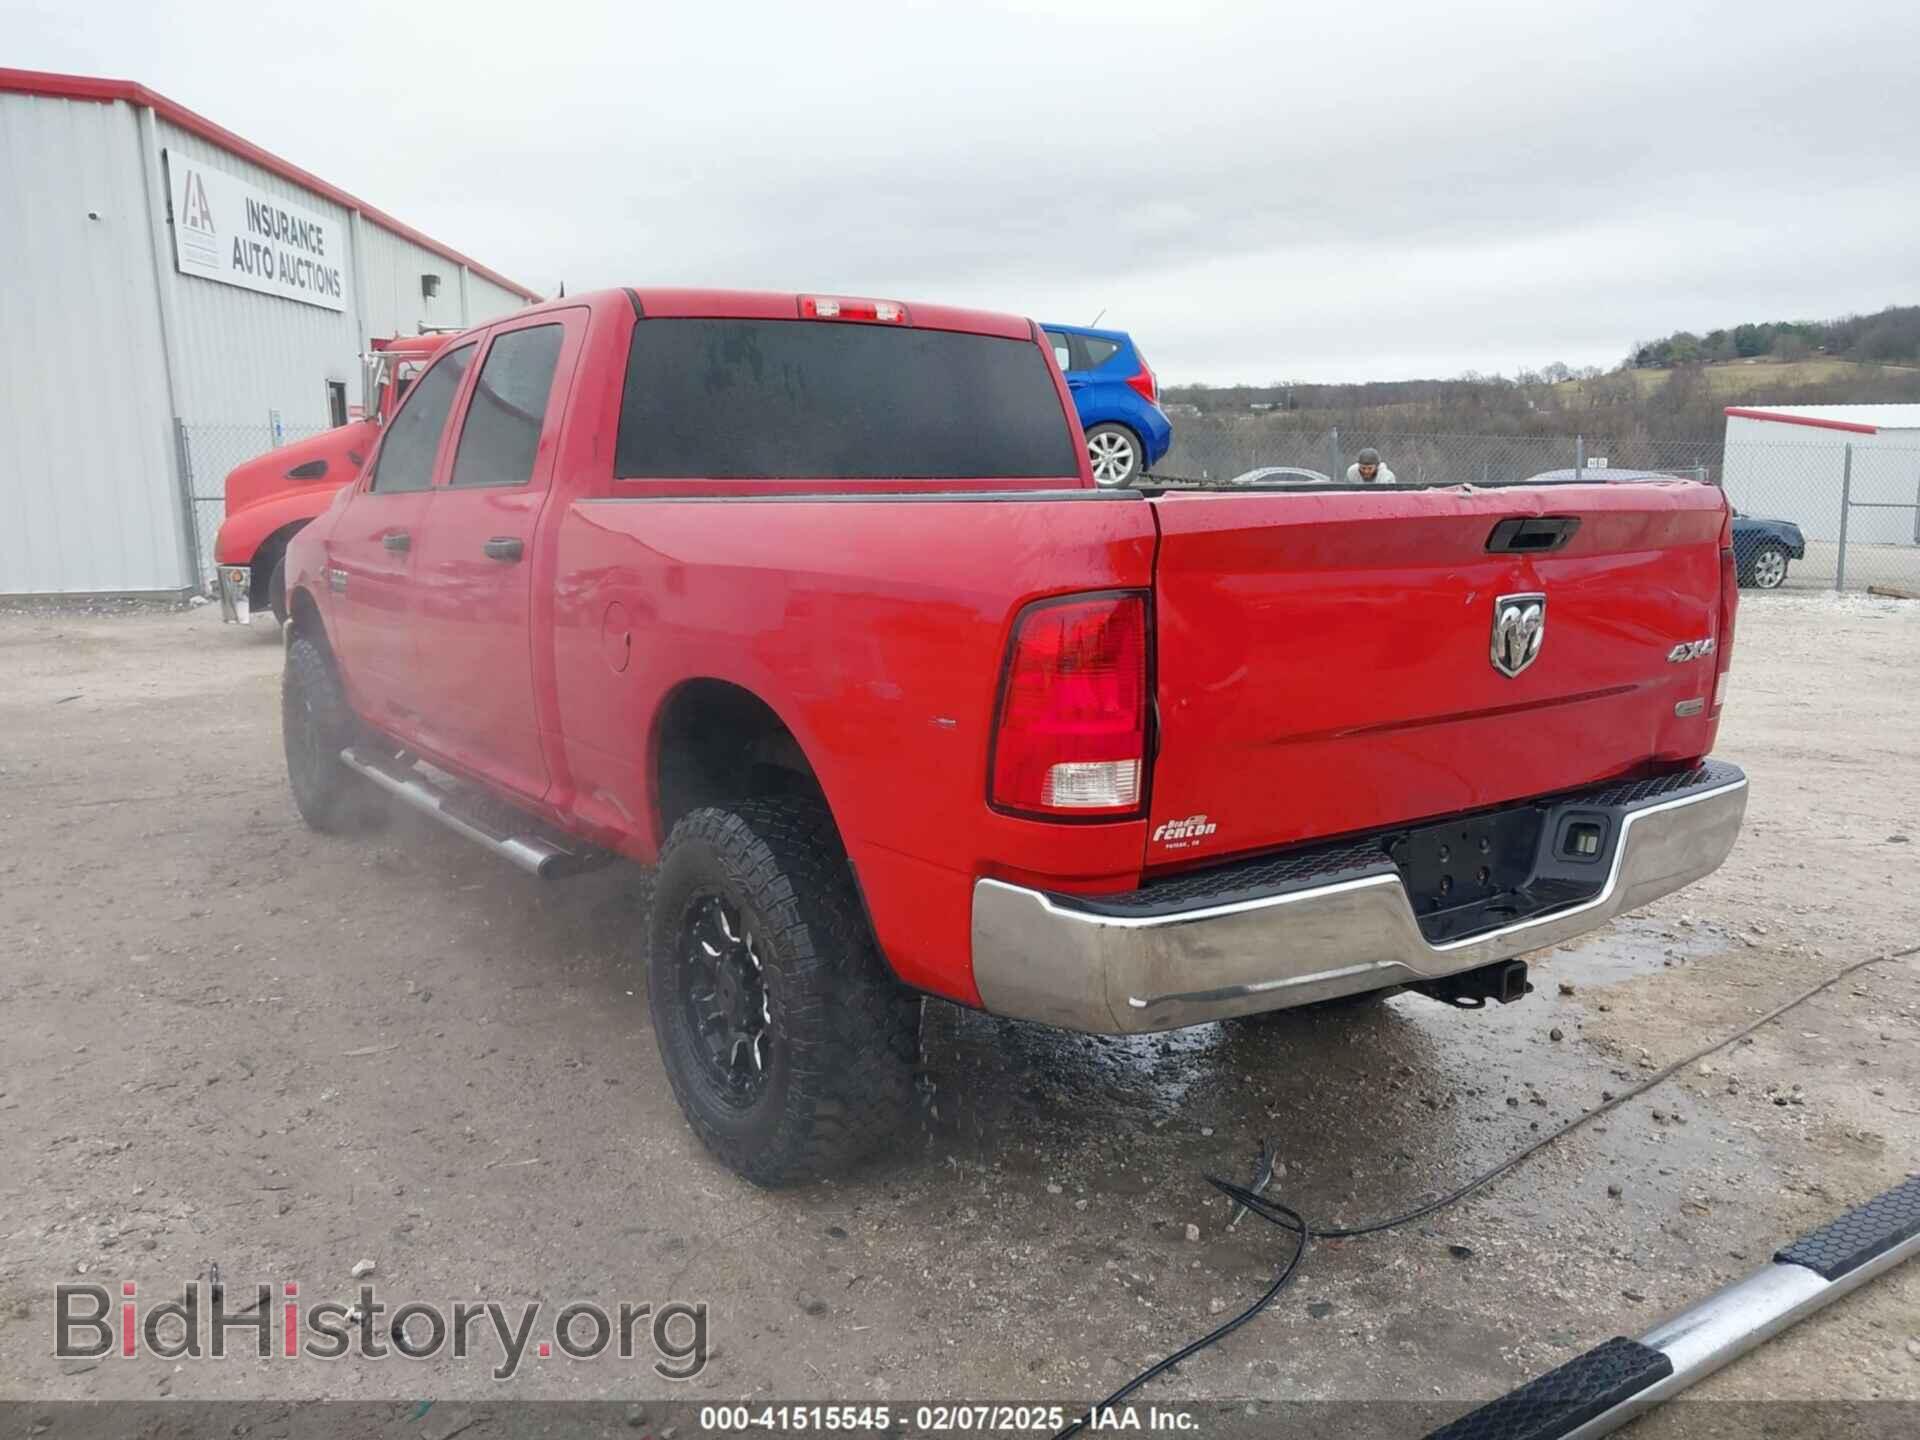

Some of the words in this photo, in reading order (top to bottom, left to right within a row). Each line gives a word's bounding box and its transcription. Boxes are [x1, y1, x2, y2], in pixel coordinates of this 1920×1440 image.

[245, 196, 325, 257] INSURANCE
[232, 236, 274, 280] AUTO
[279, 250, 341, 298] AUCTIONS
